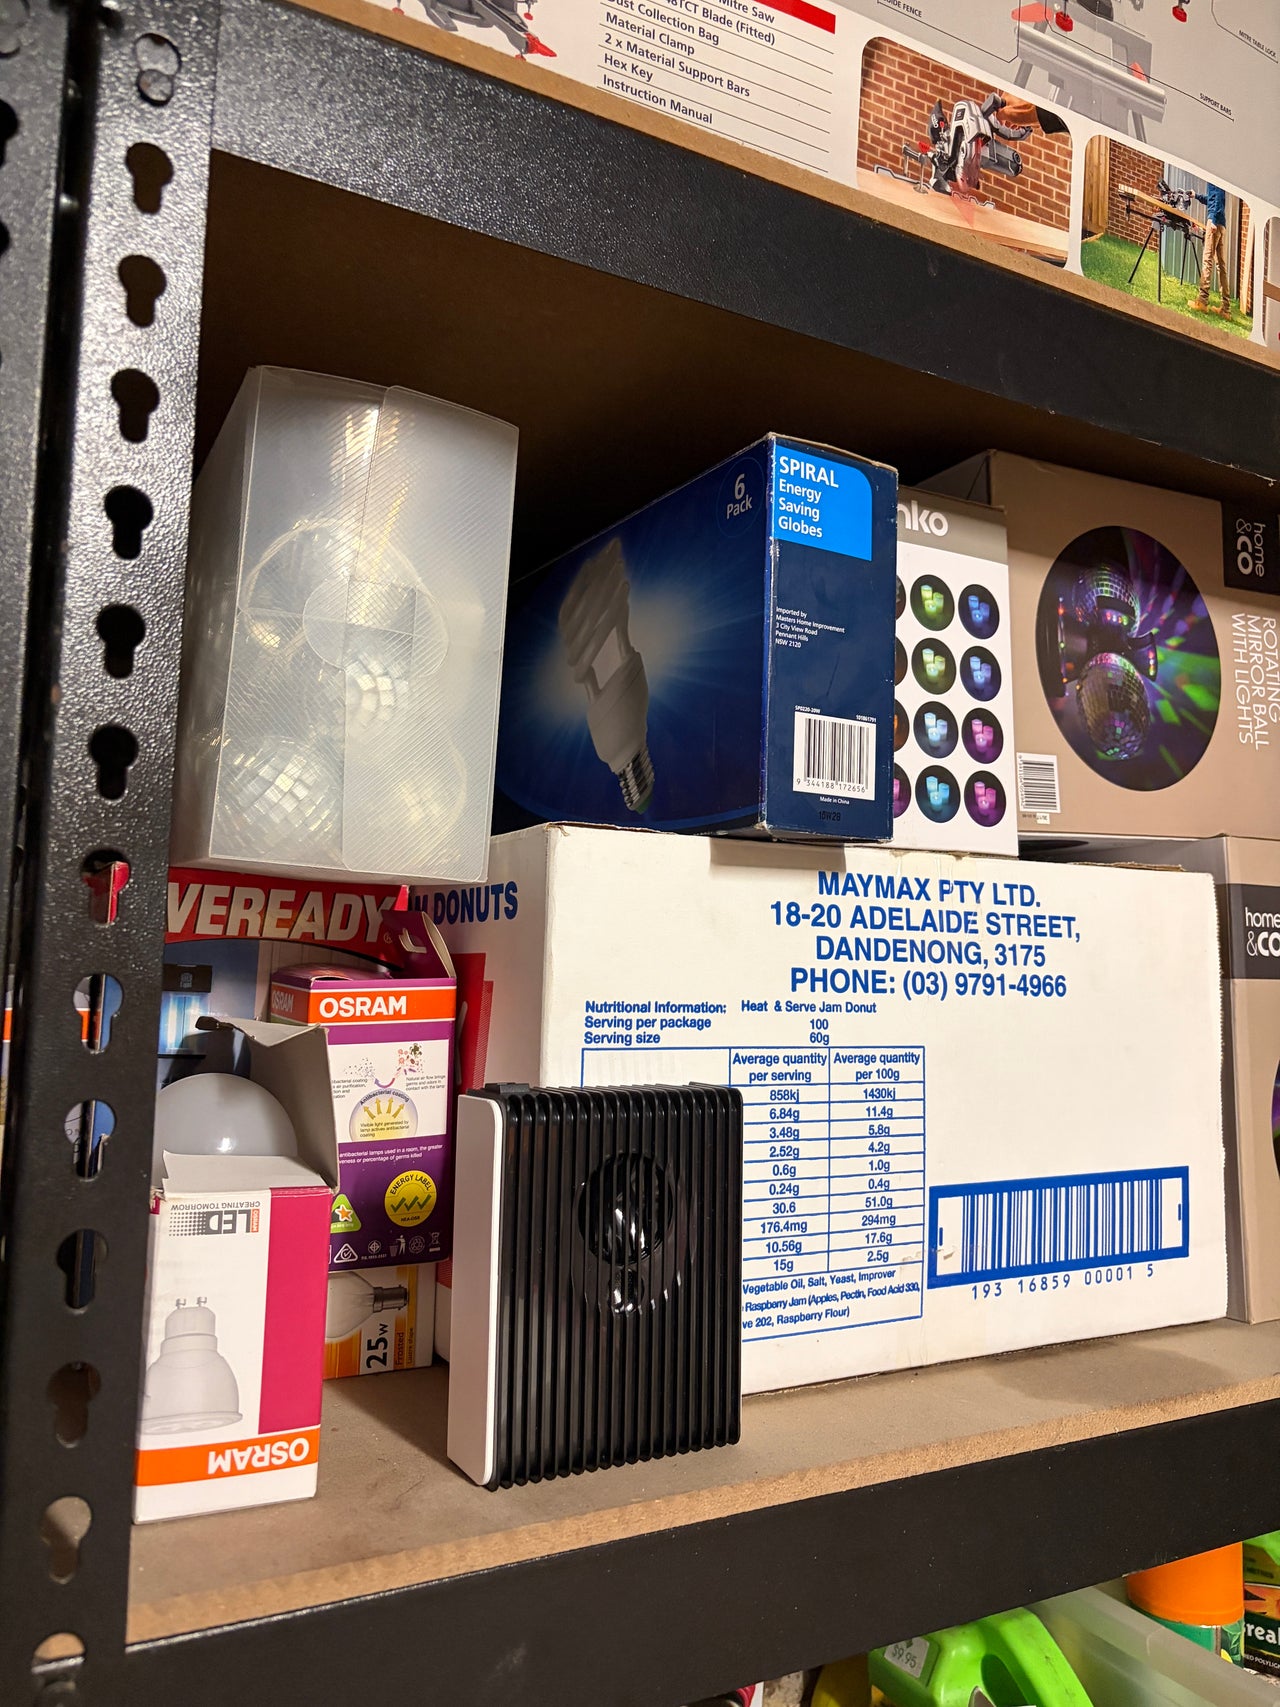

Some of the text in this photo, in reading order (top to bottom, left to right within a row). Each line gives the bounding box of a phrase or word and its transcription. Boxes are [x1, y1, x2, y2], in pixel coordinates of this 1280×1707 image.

[752, 7, 775, 24] Saw
[902, 3, 923, 18] FENCE
[609, 0, 720, 46] ust Collection Bag
[702, 7, 776, 46] Blade (Fitted)
[606, 11, 695, 56] Material Clamp
[604, 32, 751, 98] 2 x Material Support Bars
[604, 52, 654, 83] Hex Key
[603, 73, 713, 125] Instruction Manual
[1199, 92, 1220, 109] SUPPORT
[780, 456, 839, 488] SPIRAL
[734, 473, 746, 500] 6
[779, 478, 822, 504] Energy
[726, 494, 753, 520] Pack
[778, 497, 820, 522] Saving
[778, 515, 823, 538] Globes
[1253, 521, 1266, 578] home
[776, 606, 808, 619] Imported by
[776, 614, 846, 634] Masters Home Improvement
[780, 622, 791, 632] City
[791, 625, 804, 633] View
[804, 627, 818, 636] Road
[775, 630, 809, 642] Pennant Hills
[775, 638, 802, 649] NSW 2120
[1262, 615, 1280, 724] ROTATING
[1231, 612, 1254, 745] WITH LIGHTS
[1247, 613, 1270, 751] MIRROR BALL
[806, 780, 835, 790] 344188
[839, 783, 866, 794] 172656
[837, 797, 850, 805] China
[818, 870, 1041, 907] MAYMAX PTY LTD.
[433, 881, 518, 926] DONUTS
[167, 881, 401, 943] VEREADY
[1244, 906, 1280, 928] home
[770, 901, 1081, 943] 18-20 ADELAIDE STREET,
[816, 935, 1046, 969] DANDENONG, 3175
[790, 967, 1067, 1002] PHONE: (03) 9791-4966
[270, 988, 296, 1014] OSRAM
[319, 995, 407, 1019] OSRAM
[585, 1000, 651, 1013] Nutritional
[741, 999, 877, 1013] Heat & Serve Jam Donut
[584, 1015, 712, 1031] Serving per package
[809, 1018, 829, 1030] 100
[584, 1031, 661, 1047] Serving size
[809, 1031, 830, 1046] 60g
[732, 1052, 828, 1067] Average quantity
[833, 1051, 921, 1066] Average quantity
[748, 1069, 812, 1085] per serving
[855, 1068, 900, 1083] per 100g
[359, 1090, 410, 1106] Antibacterial coating
[769, 1088, 800, 1102] 858kj
[863, 1087, 897, 1101] 1430kj
[769, 1108, 800, 1122] 6.84g
[865, 1105, 893, 1118] 11.4g
[769, 1126, 800, 1140] 3.48g
[868, 1124, 891, 1136] 5.8g
[340, 1150, 368, 1158] antibacterial
[769, 1146, 800, 1160] 2.52g
[867, 1141, 891, 1155] 4.2g
[772, 1164, 797, 1178] 0.6g
[868, 1159, 891, 1172] 1.0g
[389, 1174, 432, 1195] ENERGY LABEL
[769, 1183, 800, 1197] 0.24g
[867, 1178, 891, 1192] 0.4g
[170, 1200, 261, 1211] CREATING TOMORROW
[772, 1201, 797, 1214] 30.6
[865, 1196, 893, 1209] 51.0g
[201, 1208, 252, 1236] LED
[760, 1220, 808, 1235] 176.4mg
[861, 1214, 897, 1227] 294mg
[864, 1232, 893, 1245] 17.6g
[765, 1240, 803, 1255] 10.56g
[867, 1250, 890, 1263] 2.5g
[773, 1258, 794, 1273] 15g
[743, 1269, 897, 1295] Vegetable Oil, Salt, Yeast, Improver
[971, 1263, 1155, 1300] 193 16859 00001 5
[745, 1281, 921, 1313] Raspberry Jam (Apples, Pectin, Food Acid 330,
[755, 1316, 775, 1328] 202,
[776, 1310, 823, 1326] Raspberry
[824, 1306, 850, 1319] Flour)
[207, 1436, 310, 1476] OSRAM
[891, 1643, 918, 1669] $9.95
